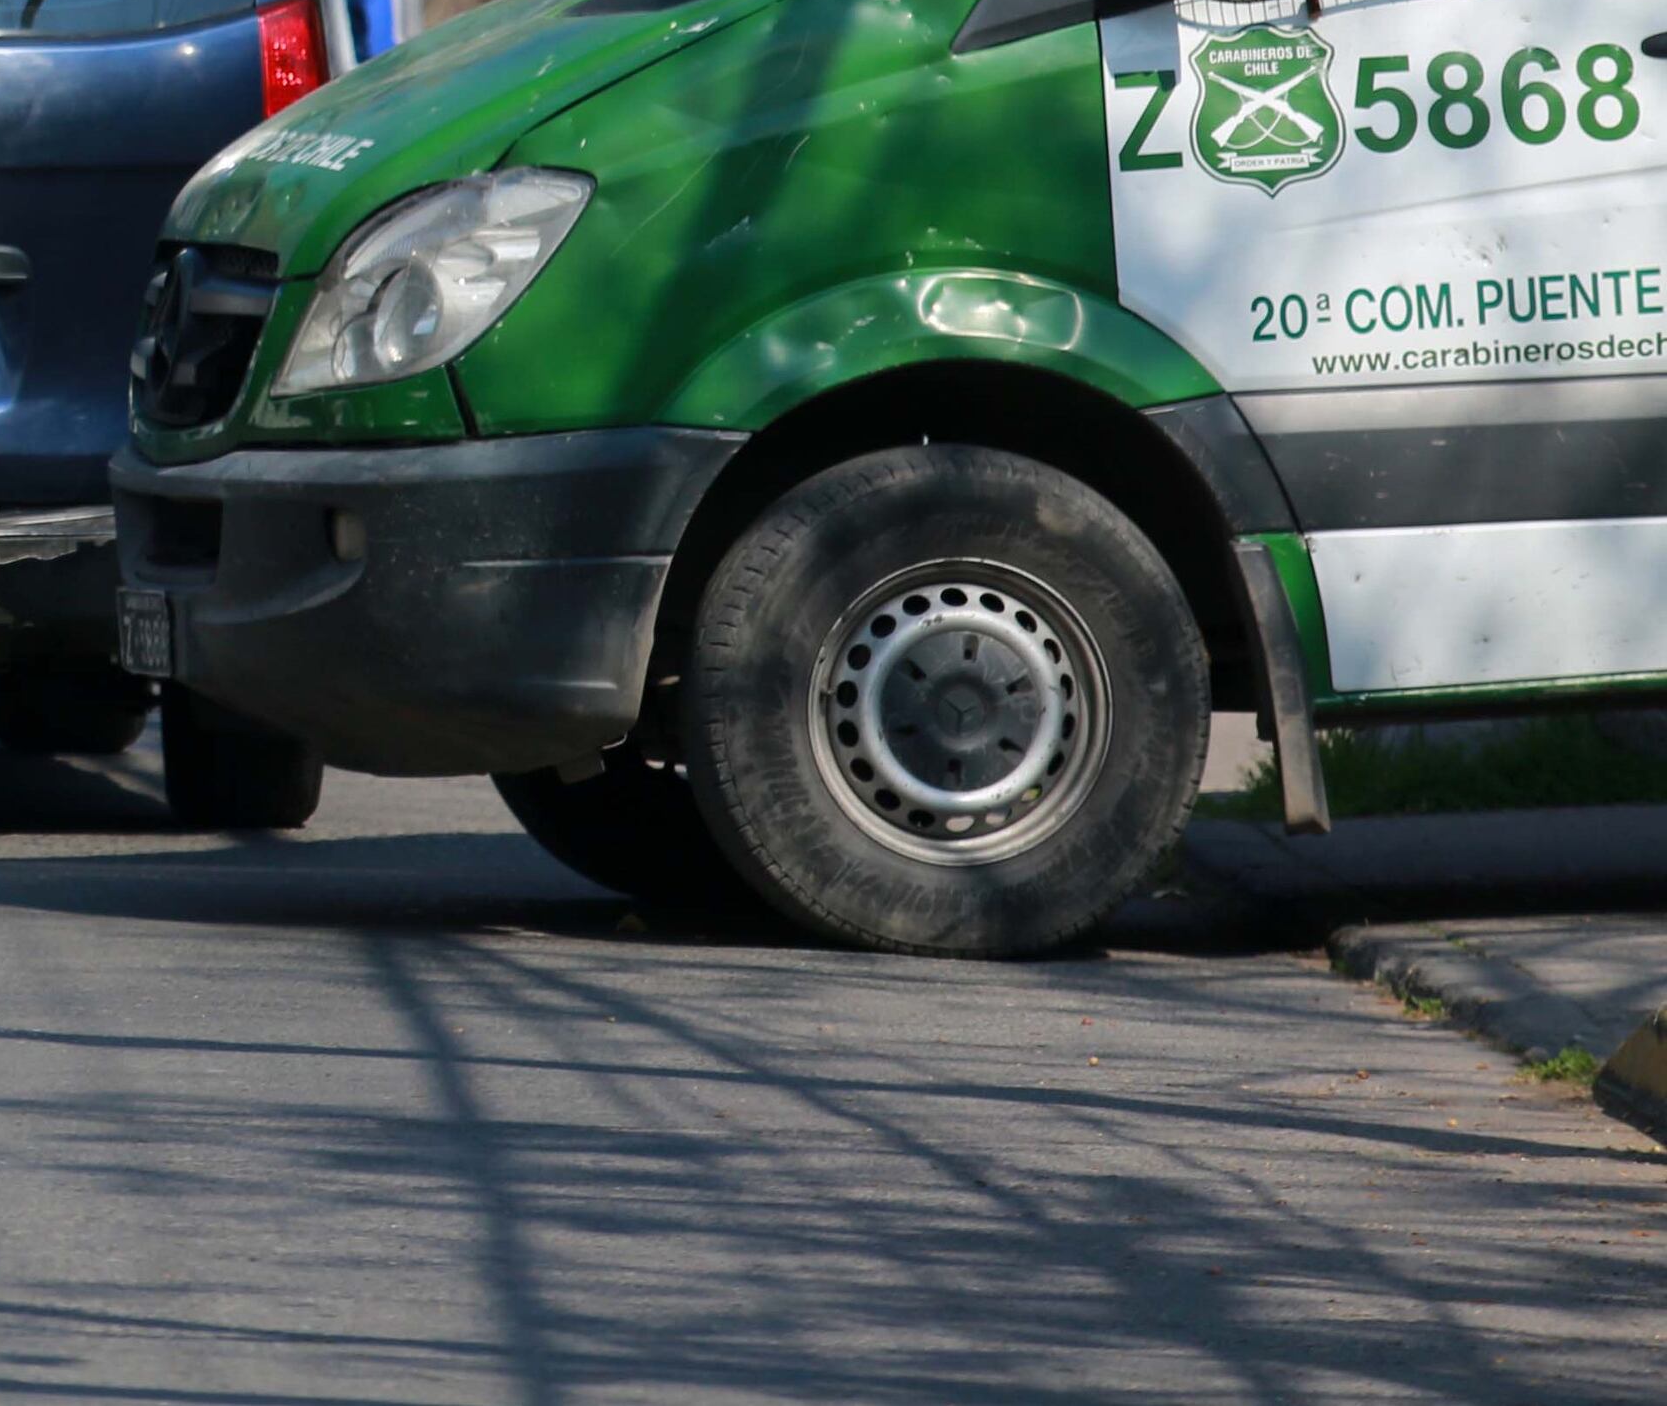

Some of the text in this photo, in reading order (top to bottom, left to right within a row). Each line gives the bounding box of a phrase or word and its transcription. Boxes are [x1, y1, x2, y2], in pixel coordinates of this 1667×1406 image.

[1208, 45, 1294, 64] CARABINEROS
[1244, 61, 1279, 76] CHILE
[1113, 43, 1641, 173] Z 5868
[1344, 281, 1465, 335] COM.
[1475, 267, 1664, 326] PUENTE
